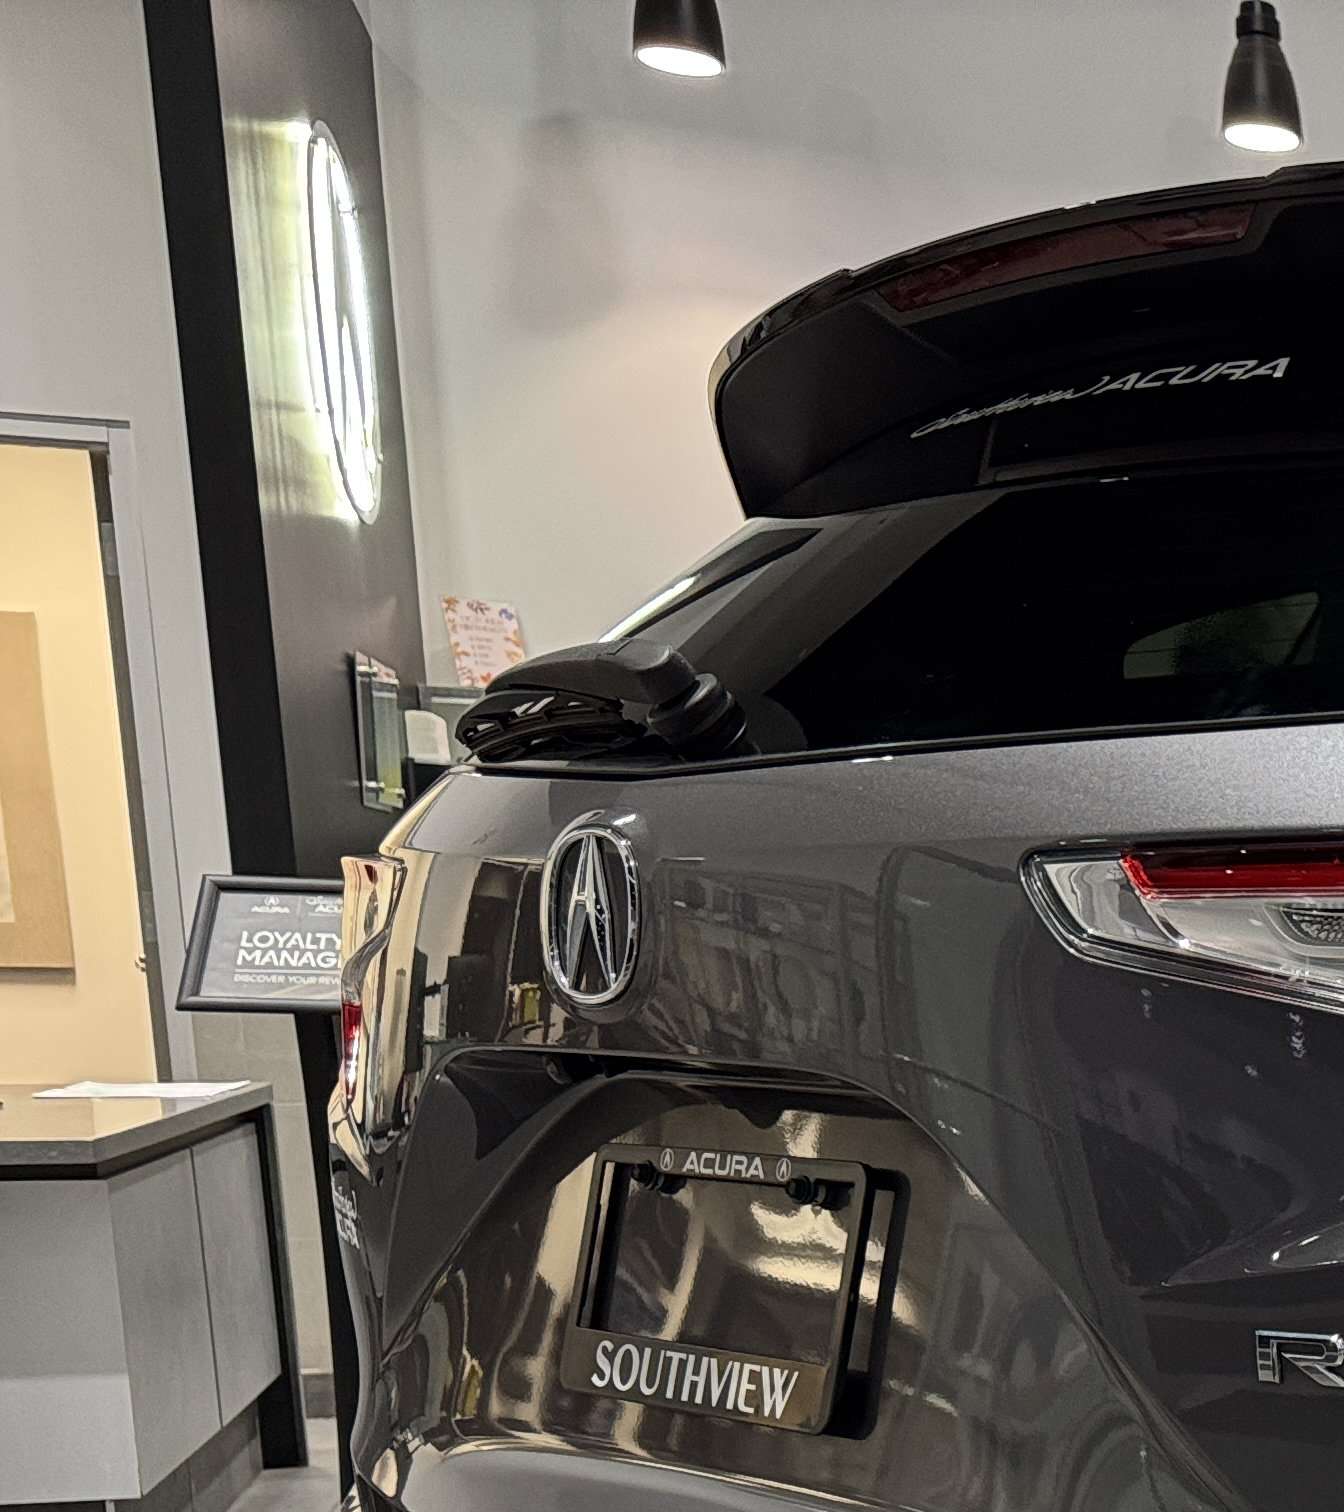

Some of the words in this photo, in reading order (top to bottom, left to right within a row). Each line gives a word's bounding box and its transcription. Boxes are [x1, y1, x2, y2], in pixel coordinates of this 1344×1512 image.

[1092, 357, 1291, 395] ACURA
[239, 930, 342, 950] LOYALTY
[233, 973, 286, 984] DISCOVER
[287, 975, 318, 985] YOUR
[682, 1151, 765, 1179] ACURA
[590, 1339, 799, 1419] SOUTHVIEW
